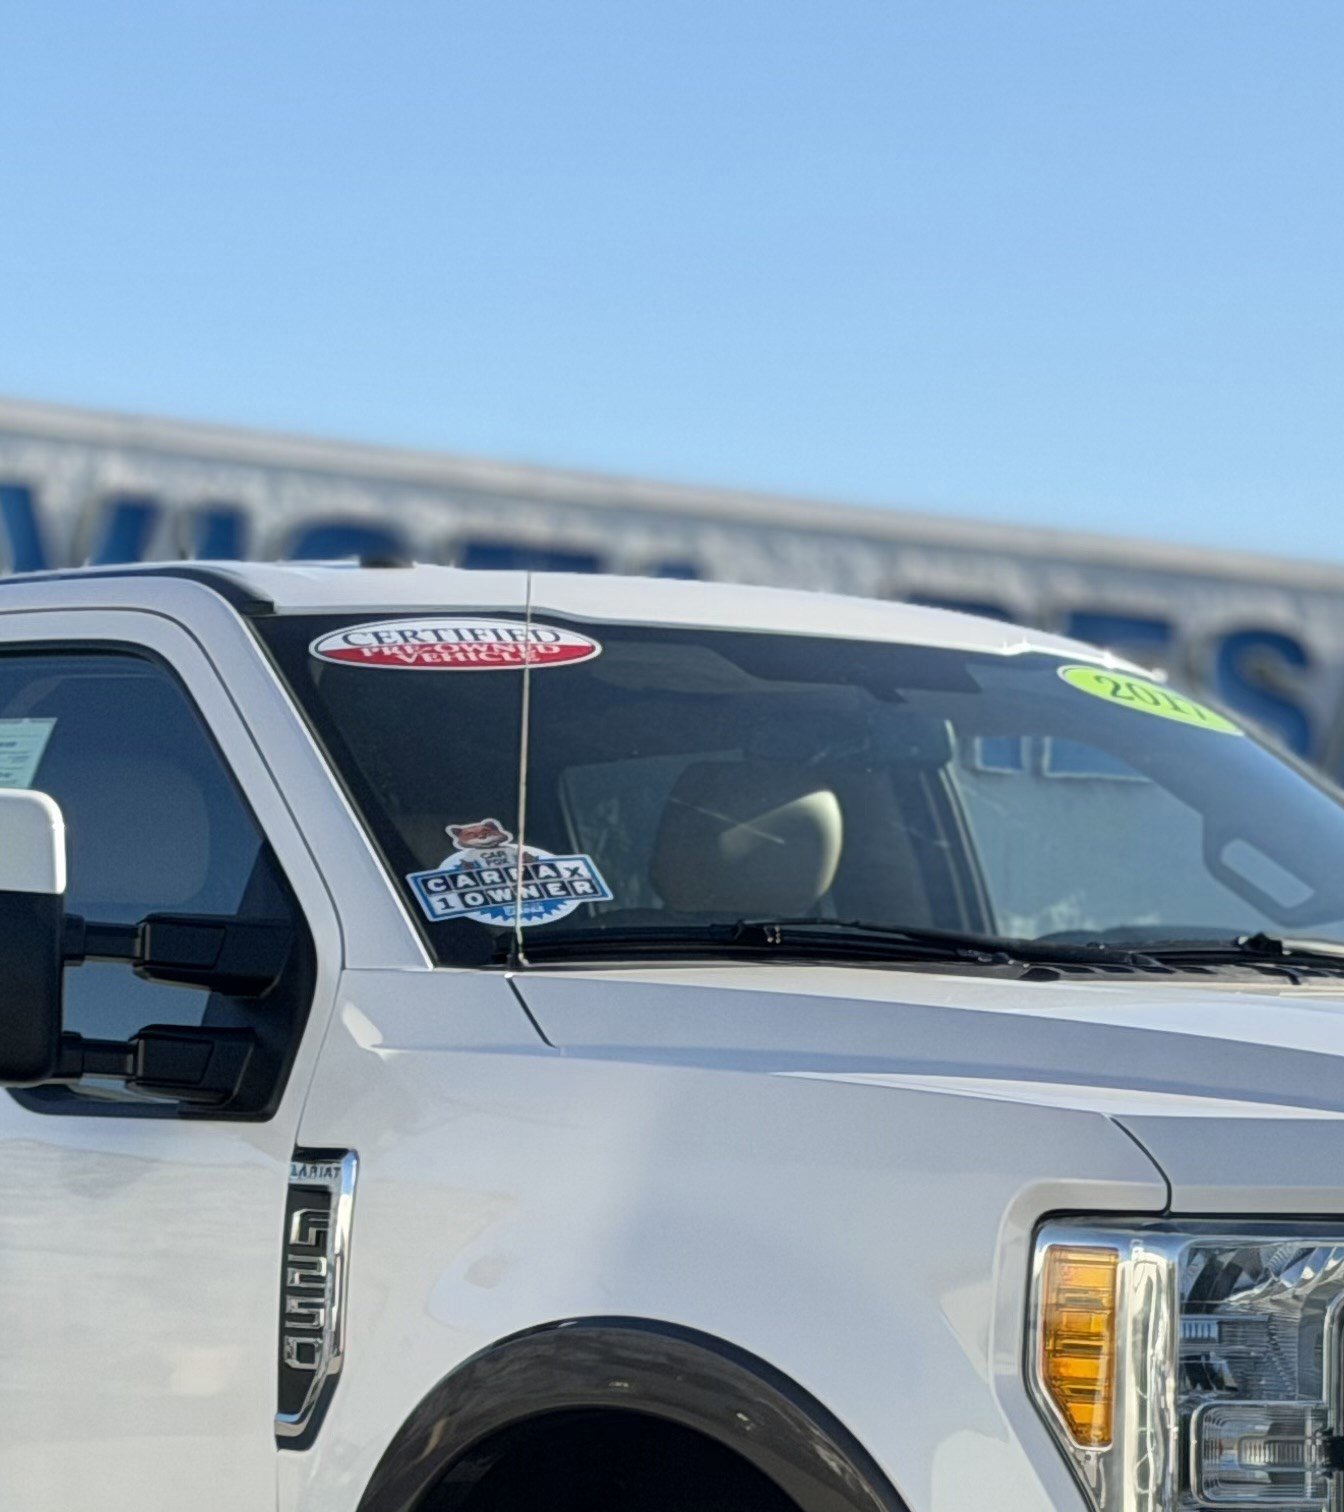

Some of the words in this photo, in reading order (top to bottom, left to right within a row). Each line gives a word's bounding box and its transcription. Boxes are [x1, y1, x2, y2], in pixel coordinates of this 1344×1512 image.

[341, 627, 561, 648] CERTIFIED
[359, 643, 561, 658] PRE-OWNED
[393, 651, 541, 664] VEHICLE
[426, 863, 587, 894] CARFAX
[290, 1163, 341, 1181] LARIAT
